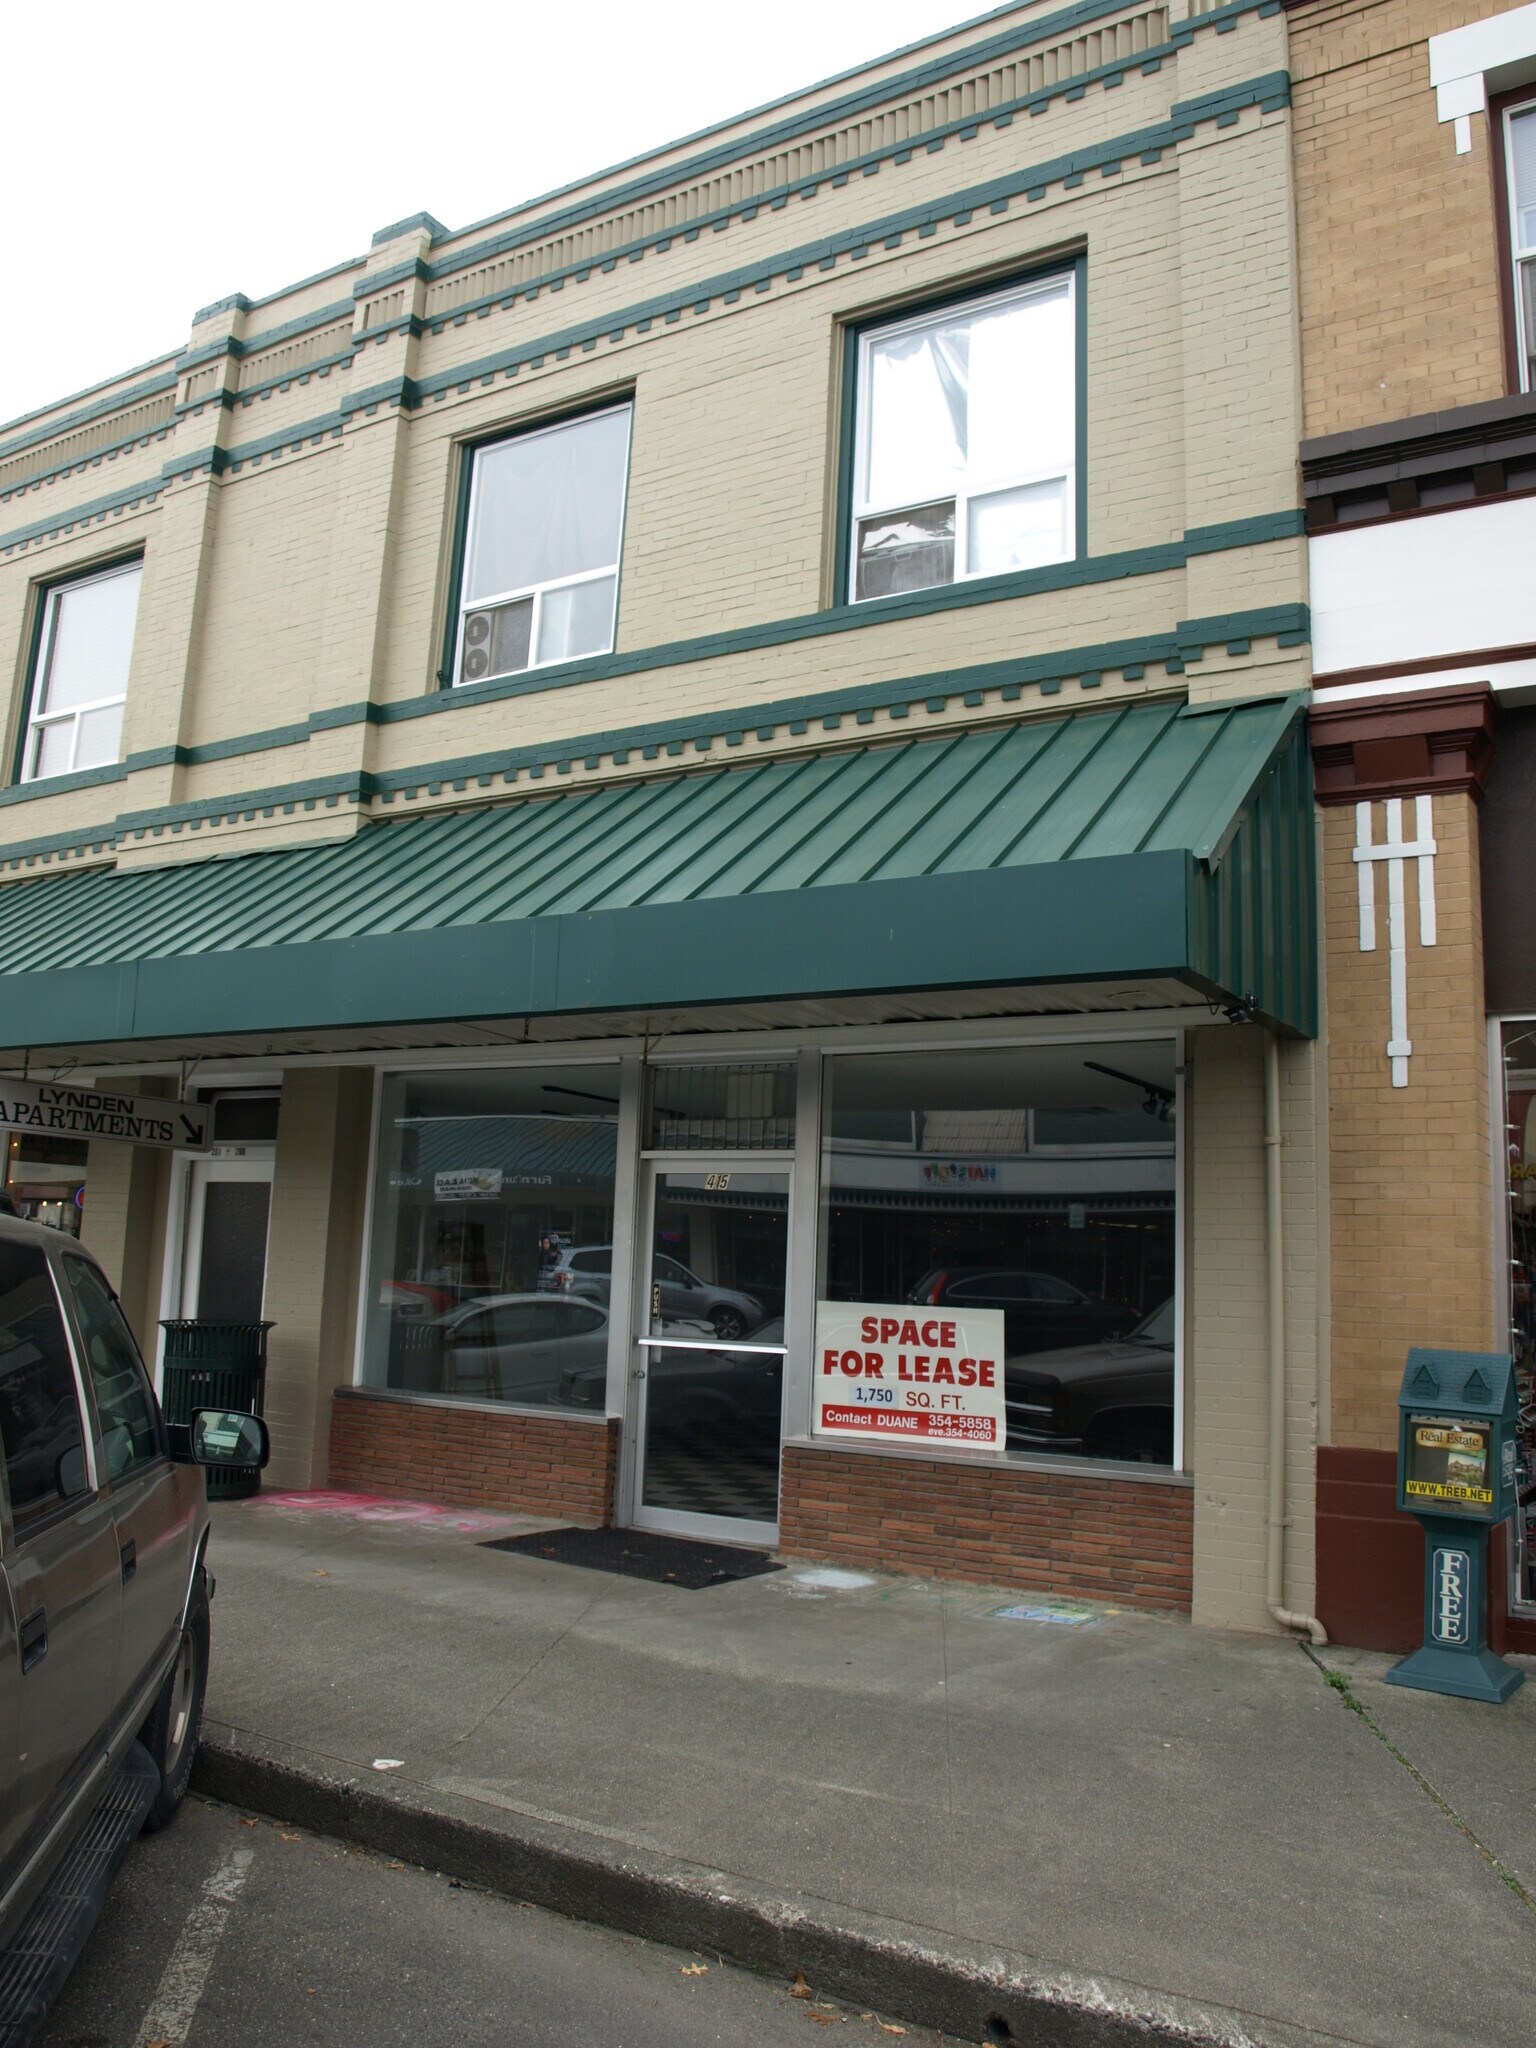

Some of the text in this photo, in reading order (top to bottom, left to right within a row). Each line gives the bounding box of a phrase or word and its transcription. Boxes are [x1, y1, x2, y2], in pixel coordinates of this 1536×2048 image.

[38, 1088, 135, 1114] LYNDEN
[0, 1100, 174, 1142] APARTMENTS
[706, 1174, 729, 1189] 415
[652, 1286, 660, 1314] PUSH
[861, 1316, 957, 1348] SPACE
[823, 1350, 995, 1388] FOR LEASE
[856, 1387, 966, 1411] 1,750 SQ. FT.
[826, 1410, 992, 1431] Contact DUANE 354-5858
[928, 1428, 992, 1441] eve.354-4060
[1420, 1430, 1480, 1447] Real Estate
[1408, 1481, 1491, 1502] WWW.TREB.NET
[1438, 1551, 1463, 1641] FREE
